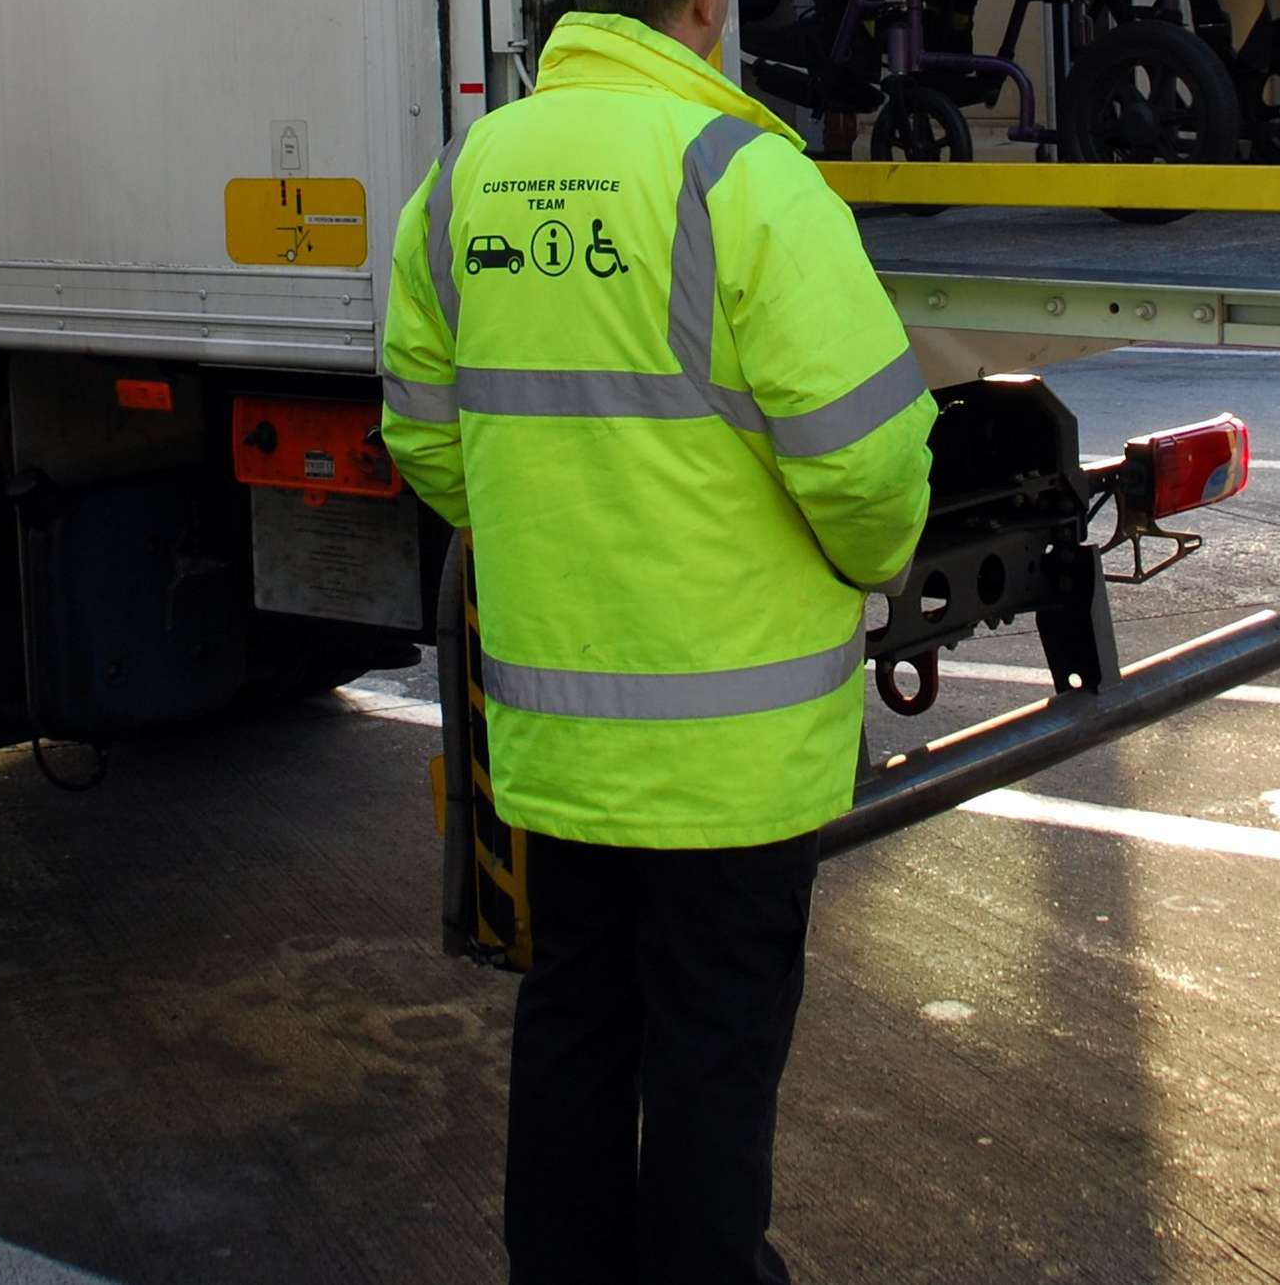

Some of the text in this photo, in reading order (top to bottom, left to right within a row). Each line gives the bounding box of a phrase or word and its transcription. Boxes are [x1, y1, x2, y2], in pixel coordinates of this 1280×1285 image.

[482, 179, 620, 194] CUSTOMER SERVICE
[528, 198, 566, 211] TEAM
